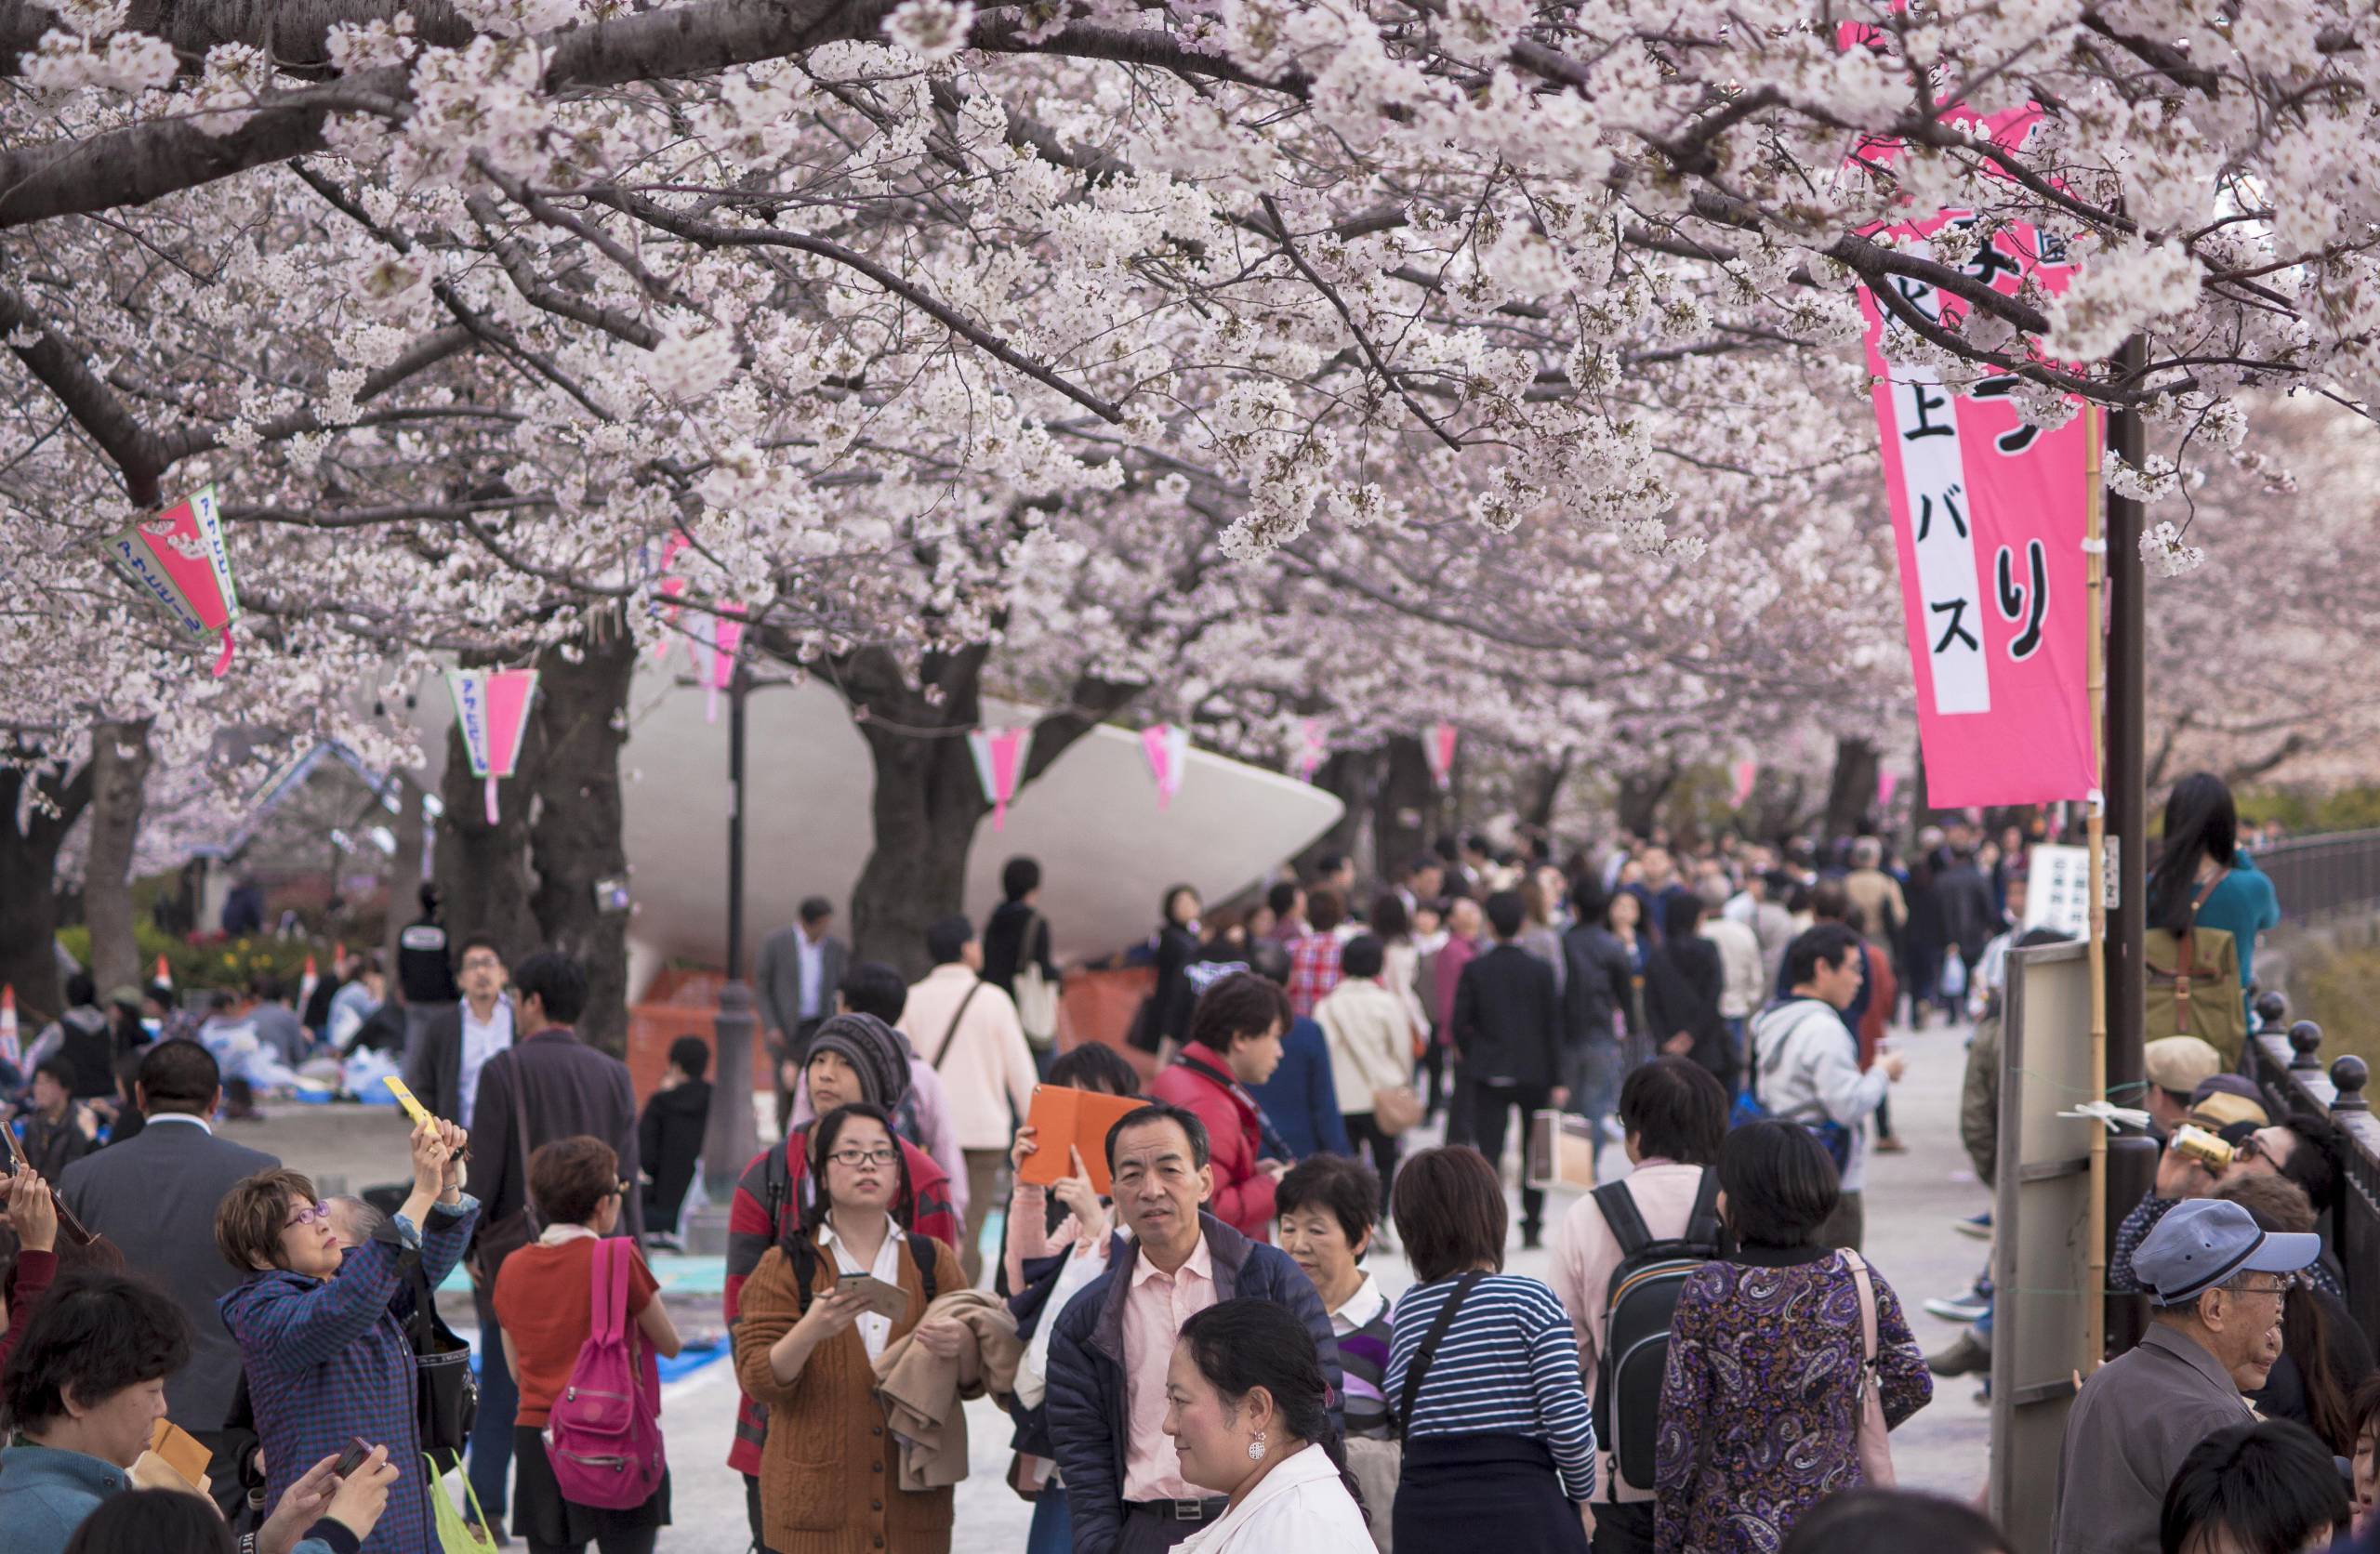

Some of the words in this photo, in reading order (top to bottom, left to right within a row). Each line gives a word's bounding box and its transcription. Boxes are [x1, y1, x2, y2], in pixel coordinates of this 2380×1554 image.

[116, 541, 201, 633] アサヒビール
